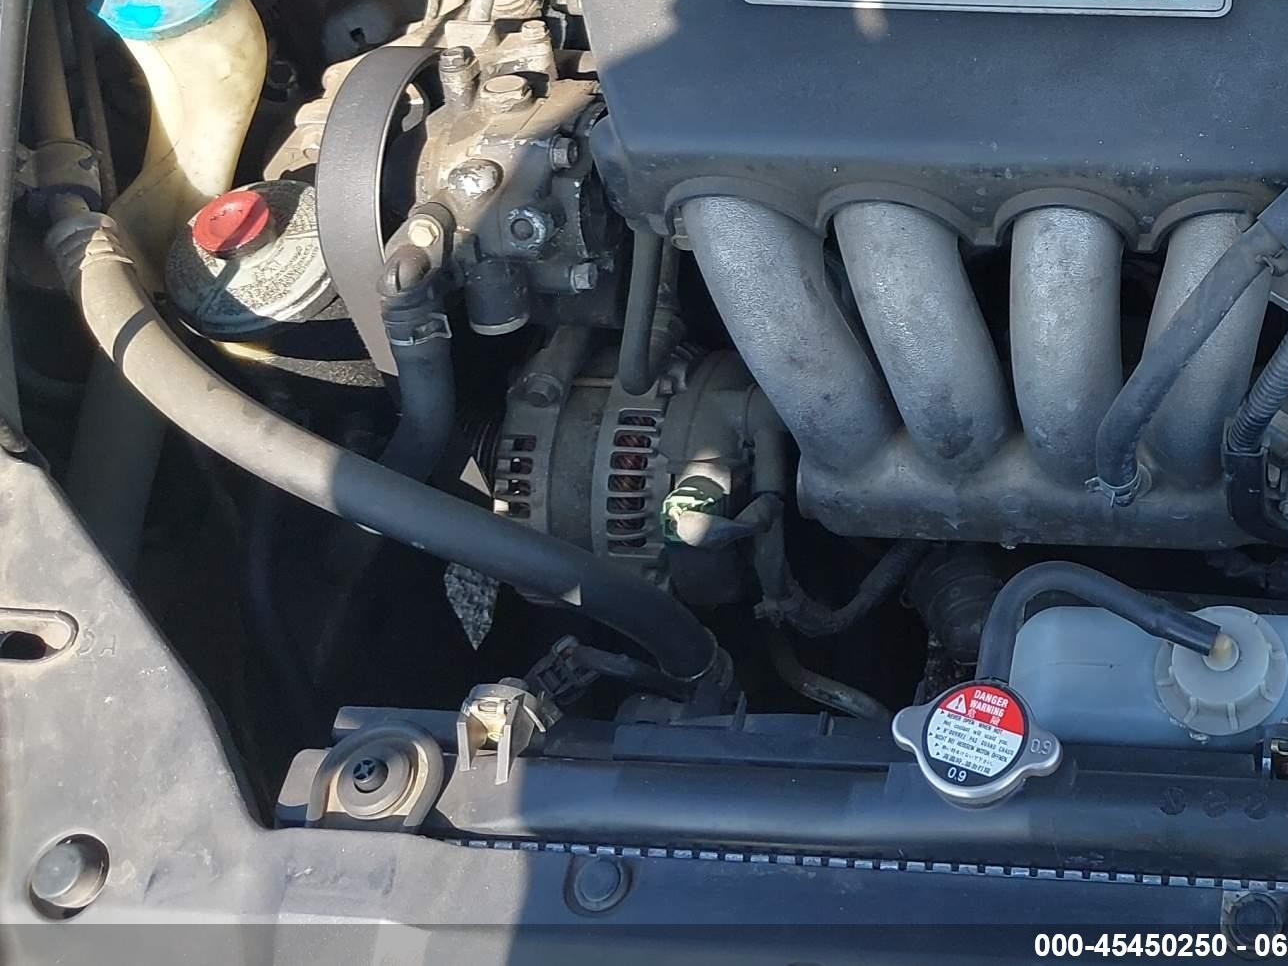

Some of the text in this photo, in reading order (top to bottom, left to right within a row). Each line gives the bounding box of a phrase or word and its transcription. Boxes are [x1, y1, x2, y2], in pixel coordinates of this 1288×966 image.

[974, 689, 1009, 708] DANGER
[970, 699, 1005, 718] WARNING
[1030, 738, 1052, 755] 0.9
[947, 766, 967, 782] 0.9
